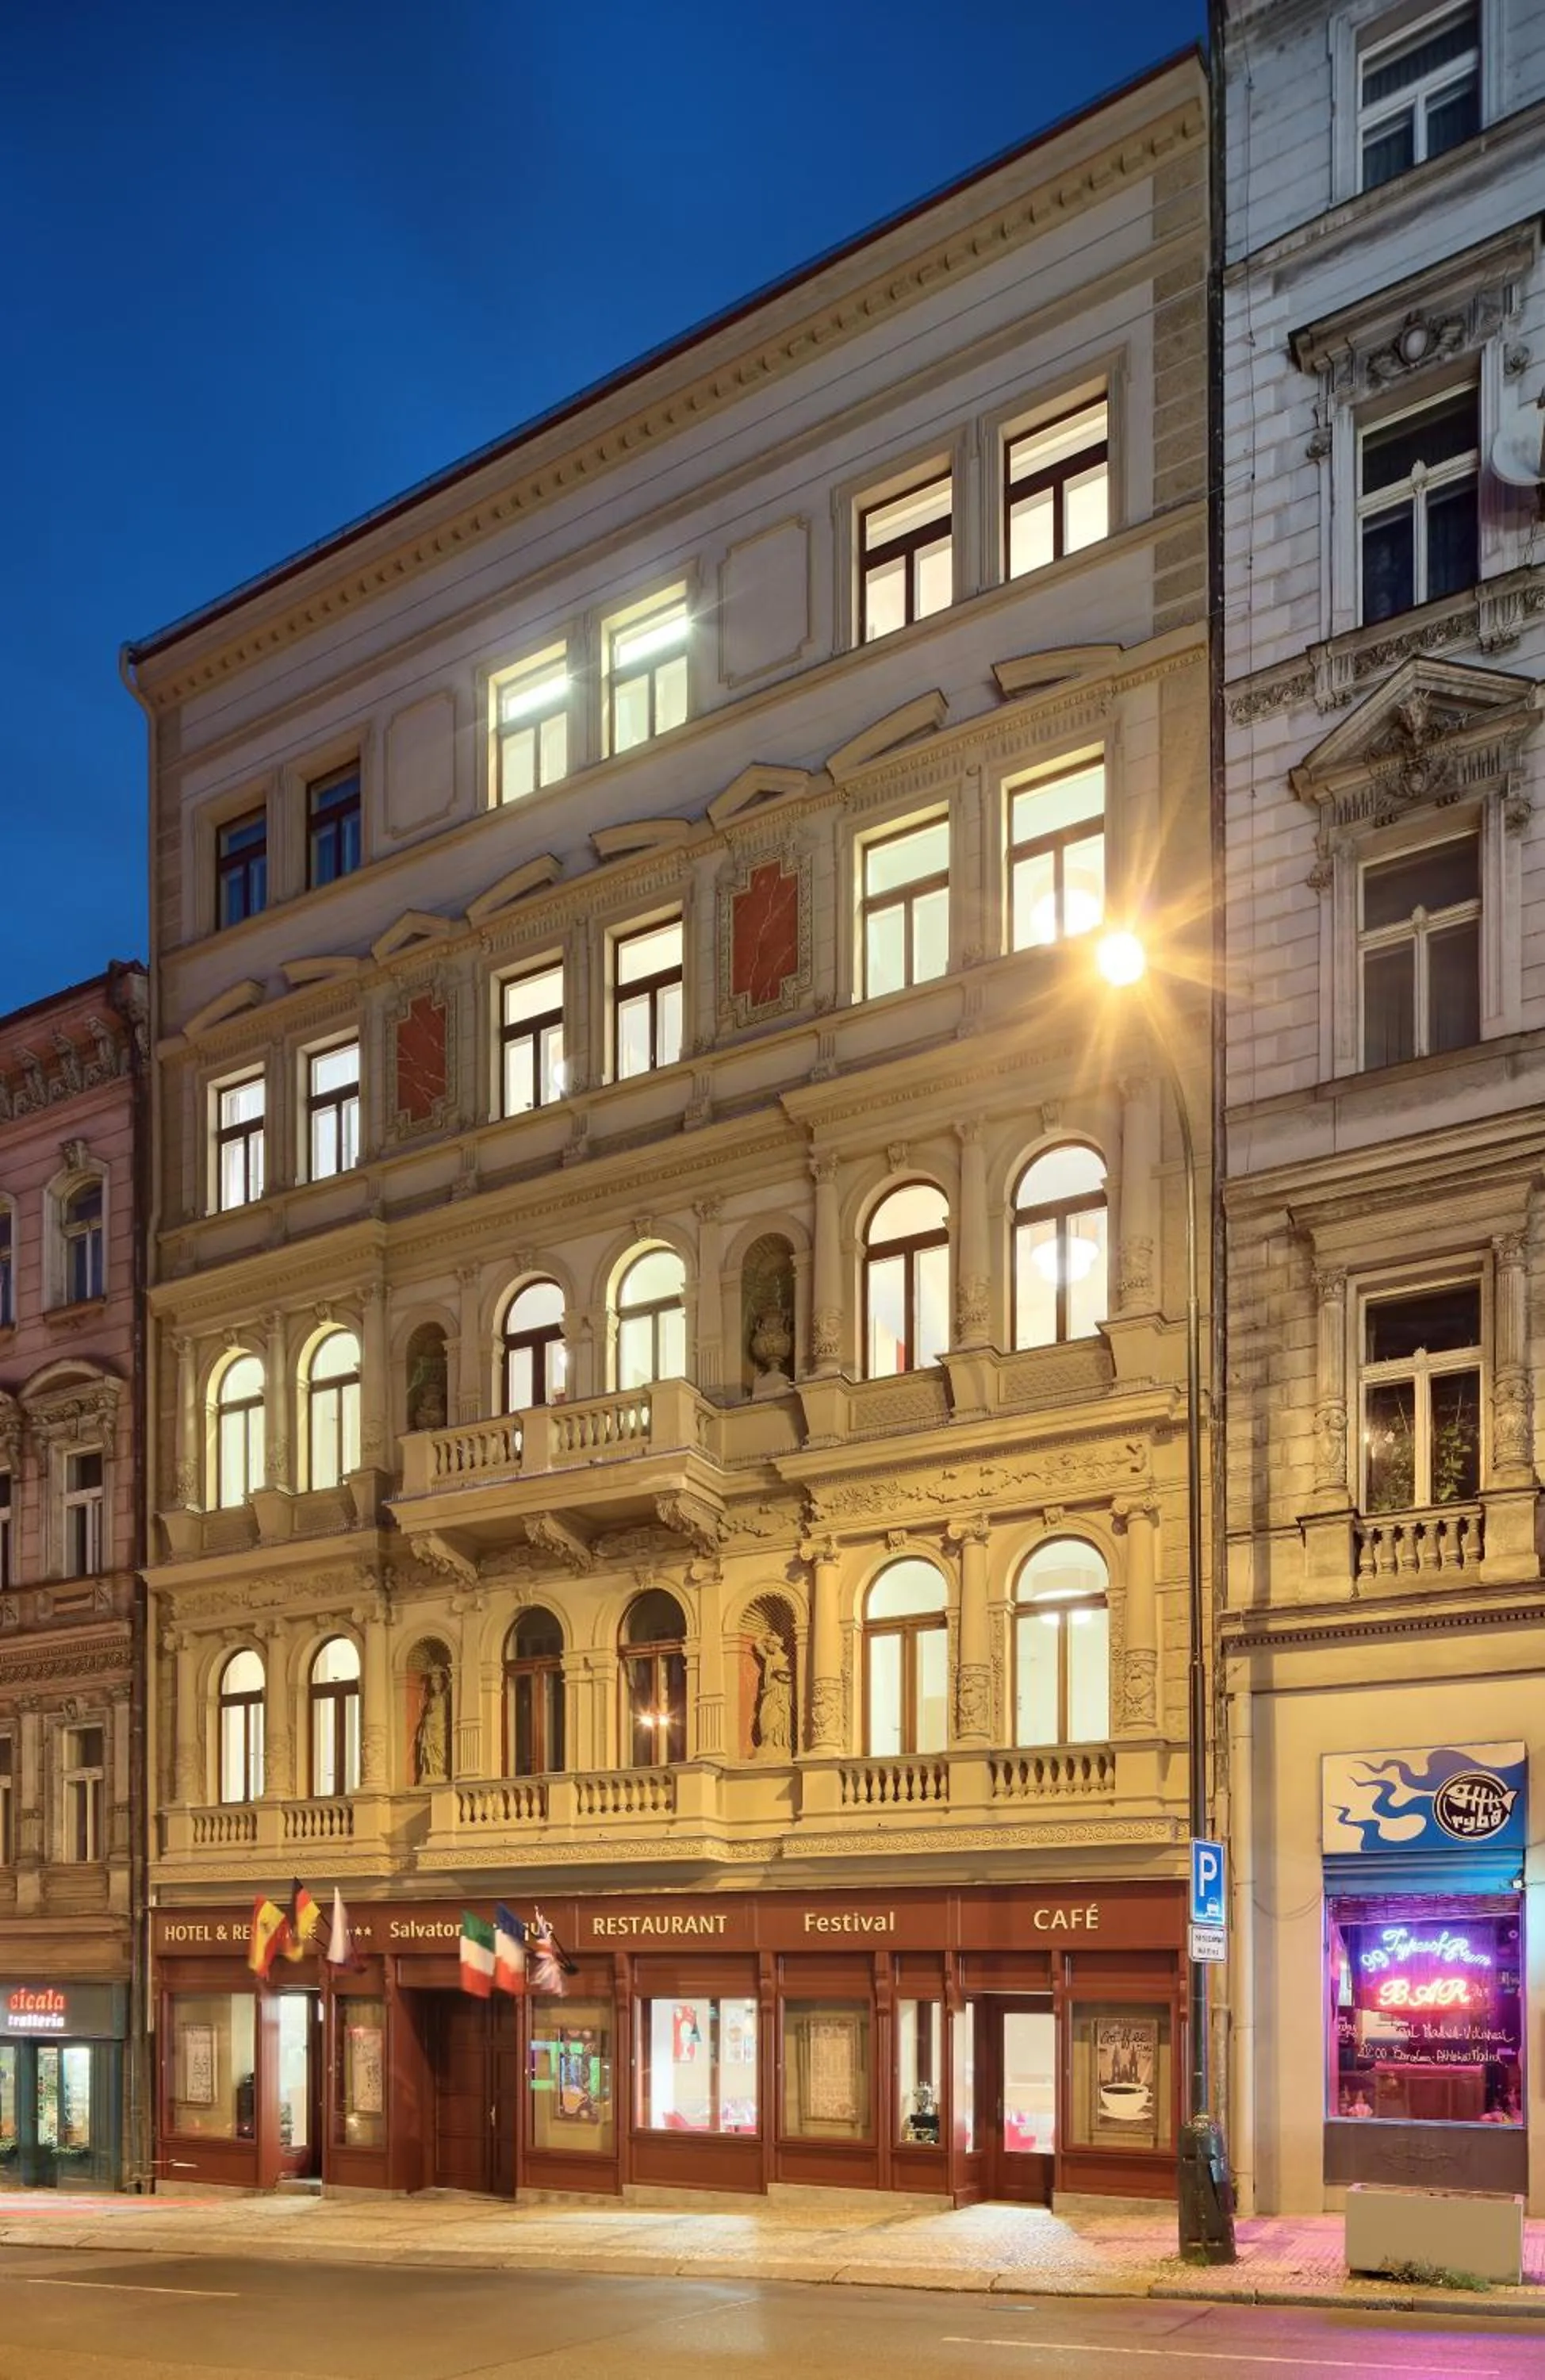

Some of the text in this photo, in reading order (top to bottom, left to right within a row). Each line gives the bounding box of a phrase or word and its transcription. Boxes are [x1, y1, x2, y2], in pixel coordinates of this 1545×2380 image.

[1198, 1851, 1217, 1897] P
[592, 1915, 728, 1936] RESTAURANT
[803, 1911, 895, 1933] Festival
[1033, 1903, 1098, 1929] CAFÉ
[164, 1925, 213, 1941] HOTEL
[216, 1925, 228, 1940] &
[389, 1920, 463, 1938] Salvator
[1361, 1949, 1389, 1972] 99
[10, 1987, 64, 2010] cicala
[1378, 1979, 1472, 2006] BAR
